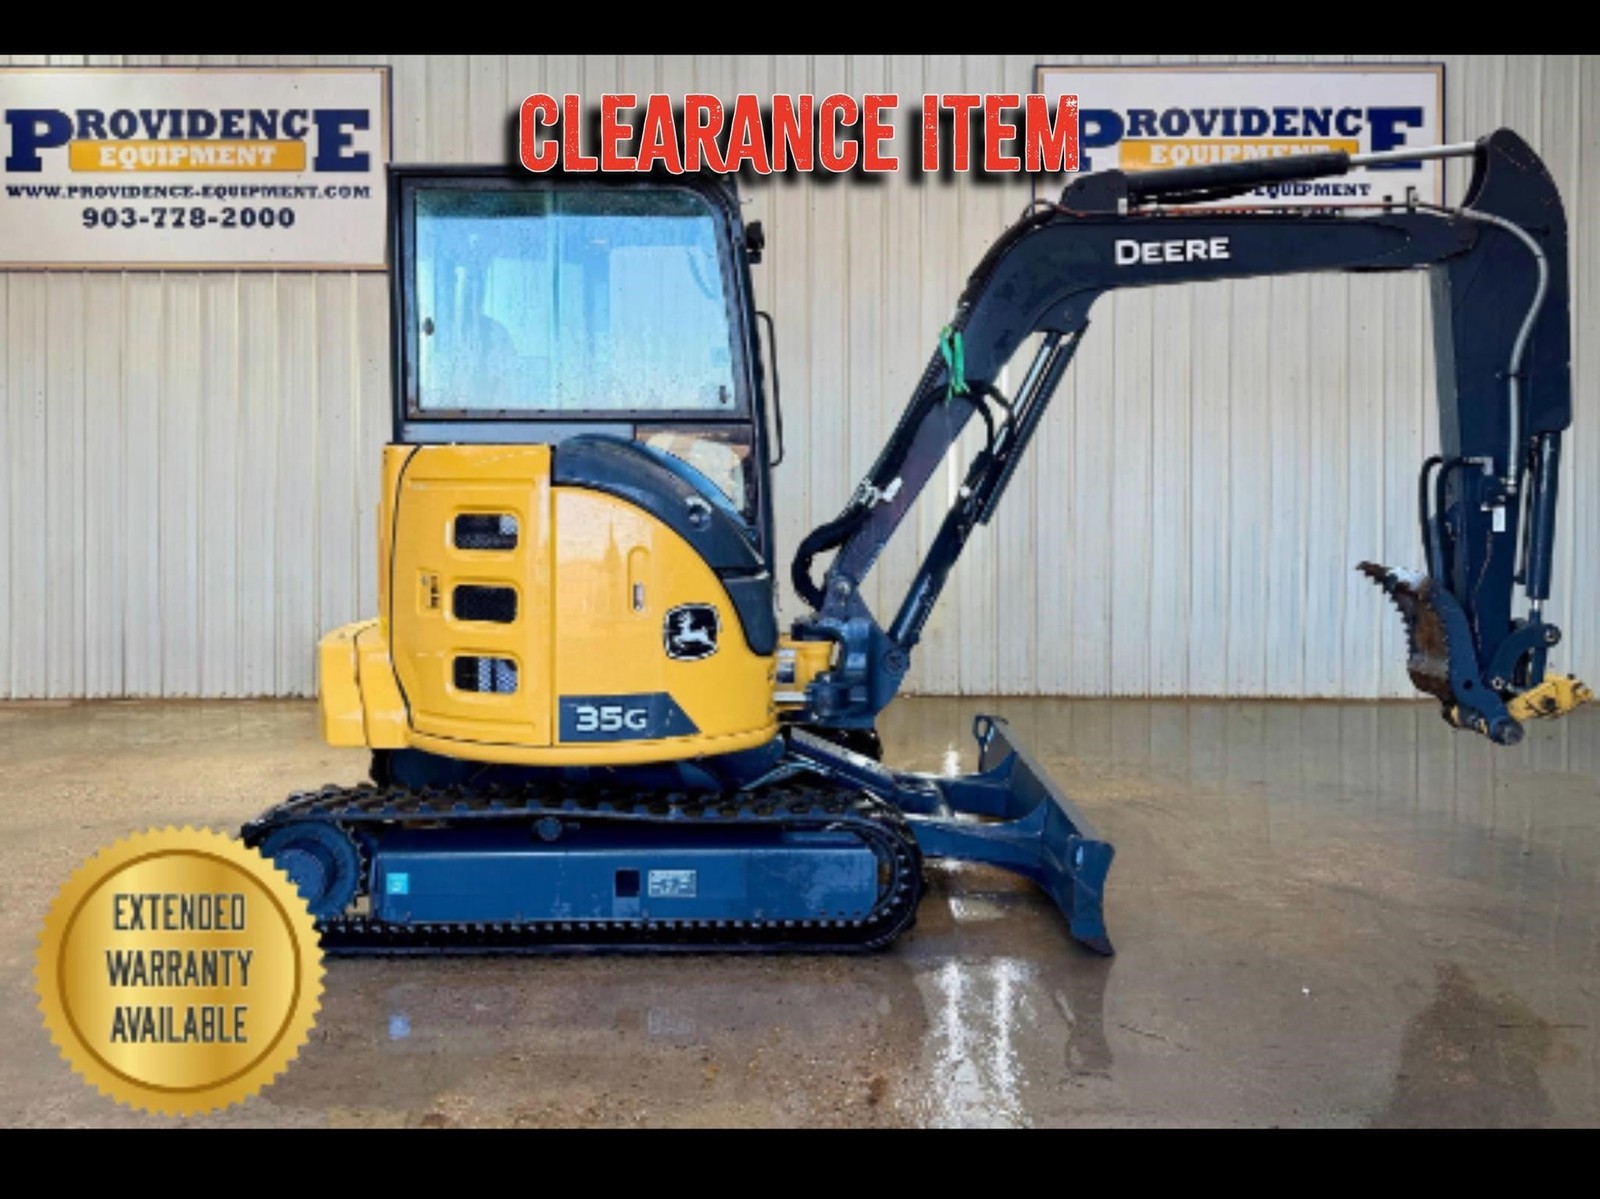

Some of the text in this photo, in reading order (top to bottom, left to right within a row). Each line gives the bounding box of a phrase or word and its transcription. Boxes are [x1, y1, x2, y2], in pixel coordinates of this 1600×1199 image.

[5, 108, 370, 172] PROVIDENCE
[1079, 107, 1422, 171] PROVIDENCE
[99, 146, 277, 169] EQUIPMENT
[6, 184, 371, 201] WWW.PROVIDENCE-EQUIPMENT.COM
[82, 207, 296, 229] 903-778-2000
[1115, 236, 1230, 266] DEERE
[576, 706, 647, 732] 35G
